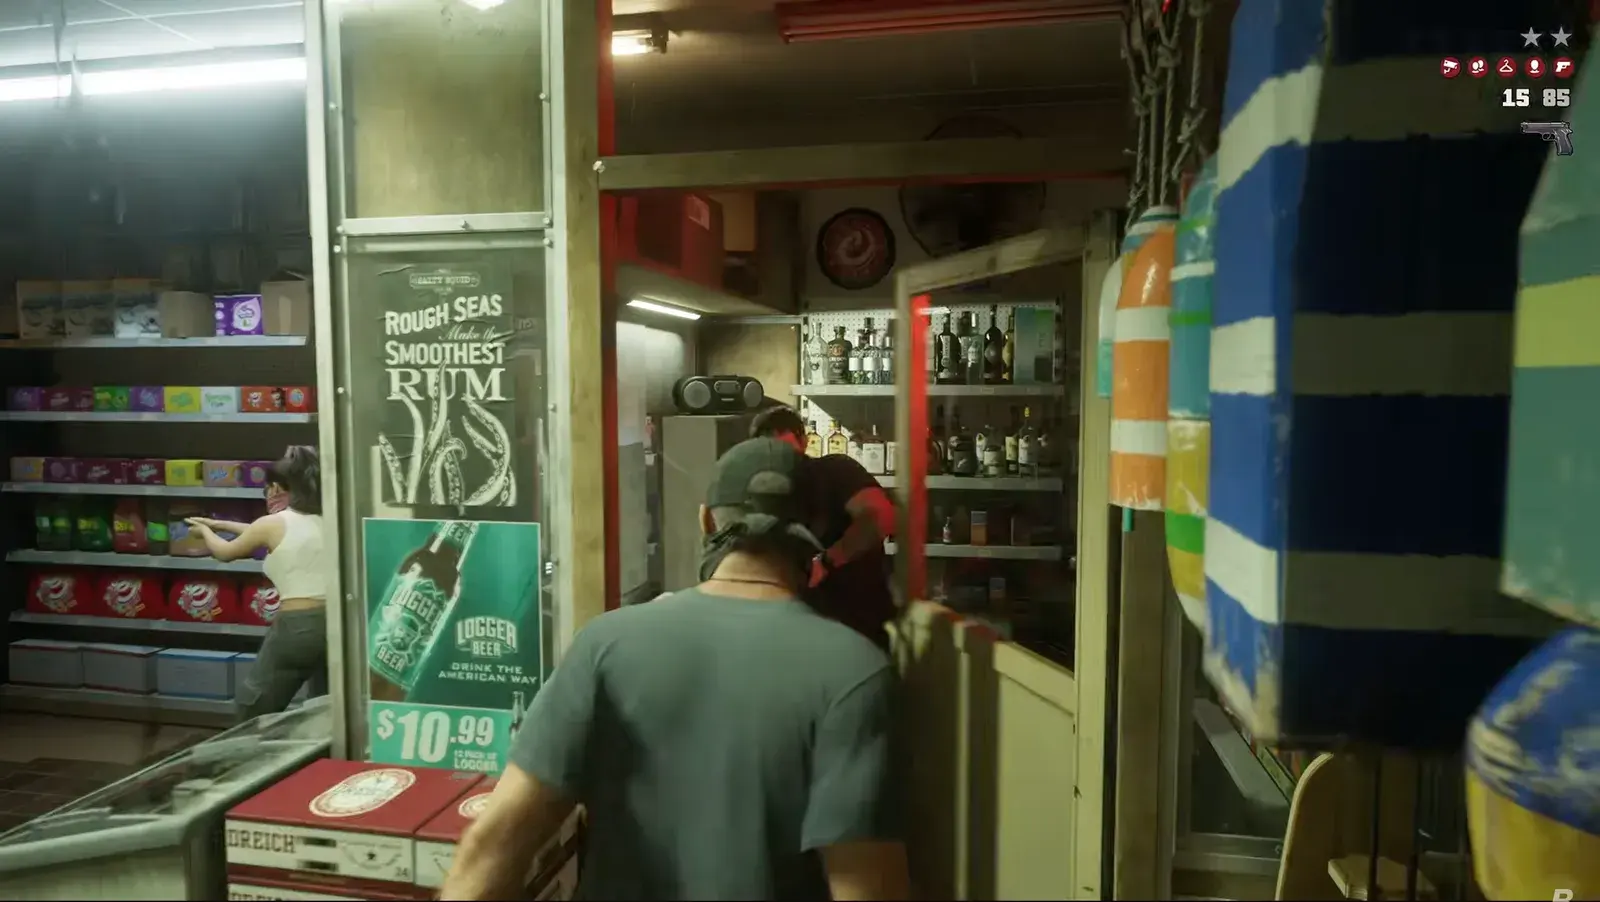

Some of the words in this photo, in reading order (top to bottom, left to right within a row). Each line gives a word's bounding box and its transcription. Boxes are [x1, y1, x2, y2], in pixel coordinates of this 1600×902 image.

[385, 303, 449, 335] ROUGH
[453, 294, 502, 322] SEAS
[438, 323, 480, 341] Make
[384, 341, 506, 366] SMOOTHEST
[385, 367, 507, 401] RUM
[457, 617, 517, 650] LOGGER
[376, 644, 407, 672] BEER
[472, 641, 502, 657] BEER
[438, 671, 506, 682] AMERICAN
[510, 675, 537, 684] WAY
[451, 662, 492, 673] DRINK
[496, 664, 523, 675] THE
[376, 708, 495, 763] $10.99
[454, 758, 498, 771] LOGGER
[227, 829, 296, 854] DREICH
